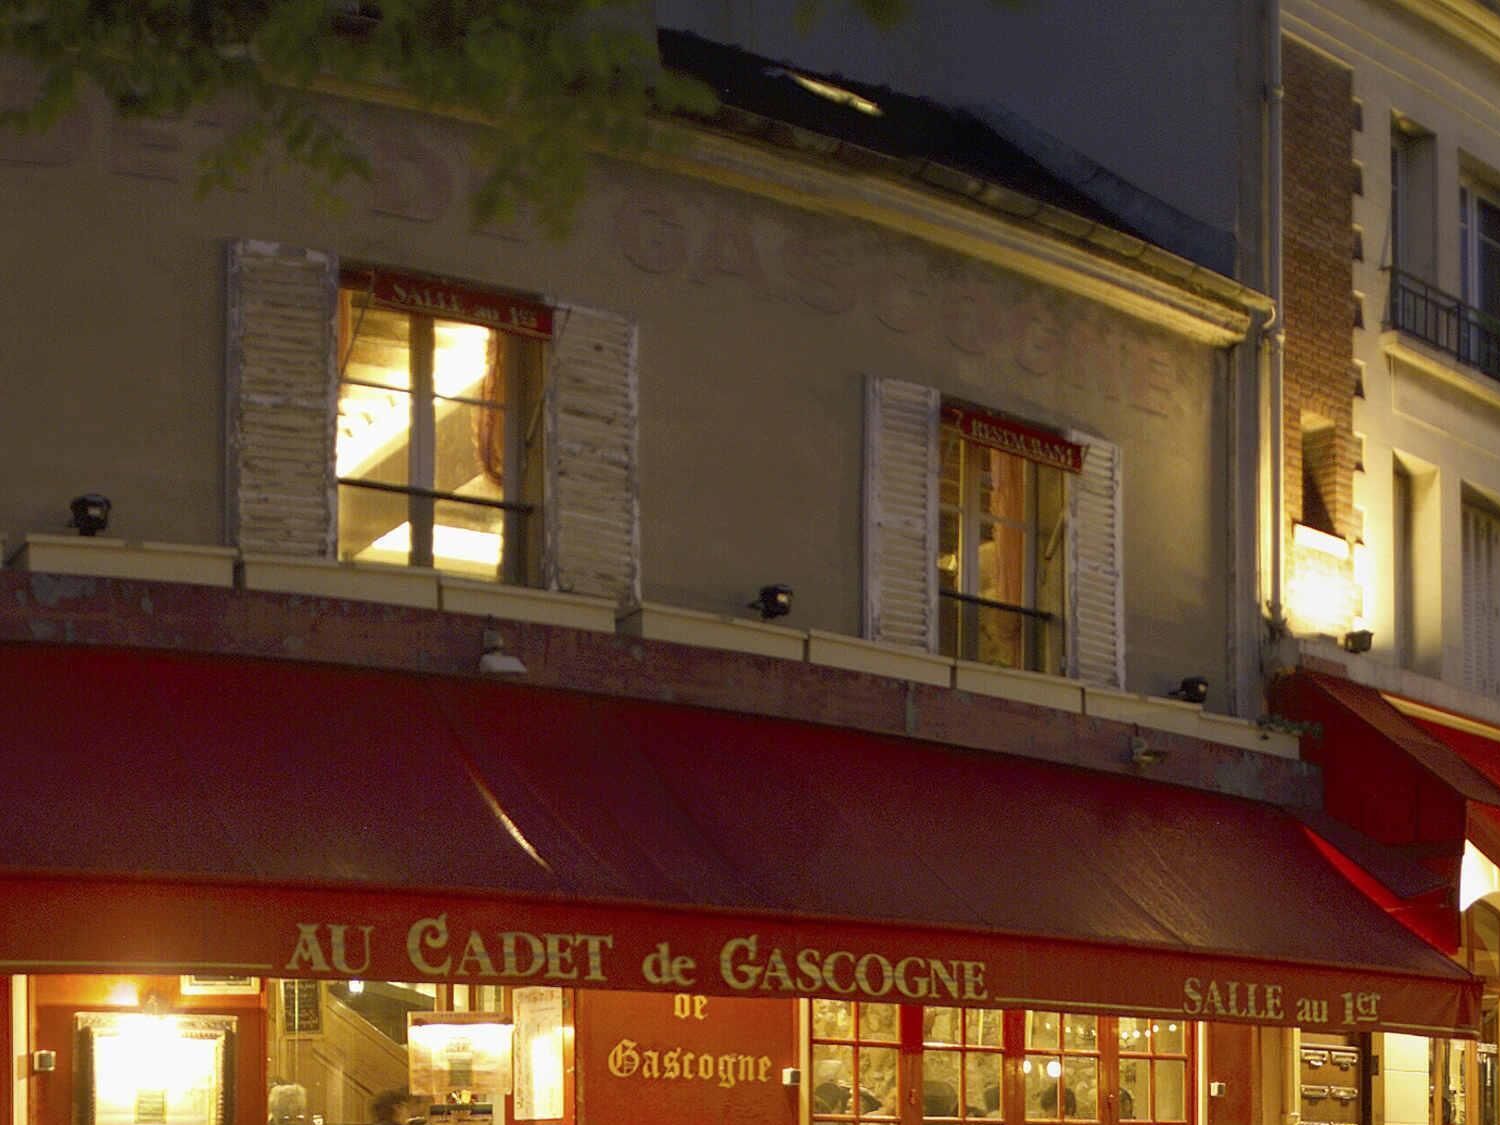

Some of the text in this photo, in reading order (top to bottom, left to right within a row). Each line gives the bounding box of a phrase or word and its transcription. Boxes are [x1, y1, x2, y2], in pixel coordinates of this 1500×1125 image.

[286, 913, 988, 1000] AU CADET de GASCOGNE
[1183, 977, 1381, 1025] SALLE au 1er
[607, 1038, 772, 1088] Gascogne
